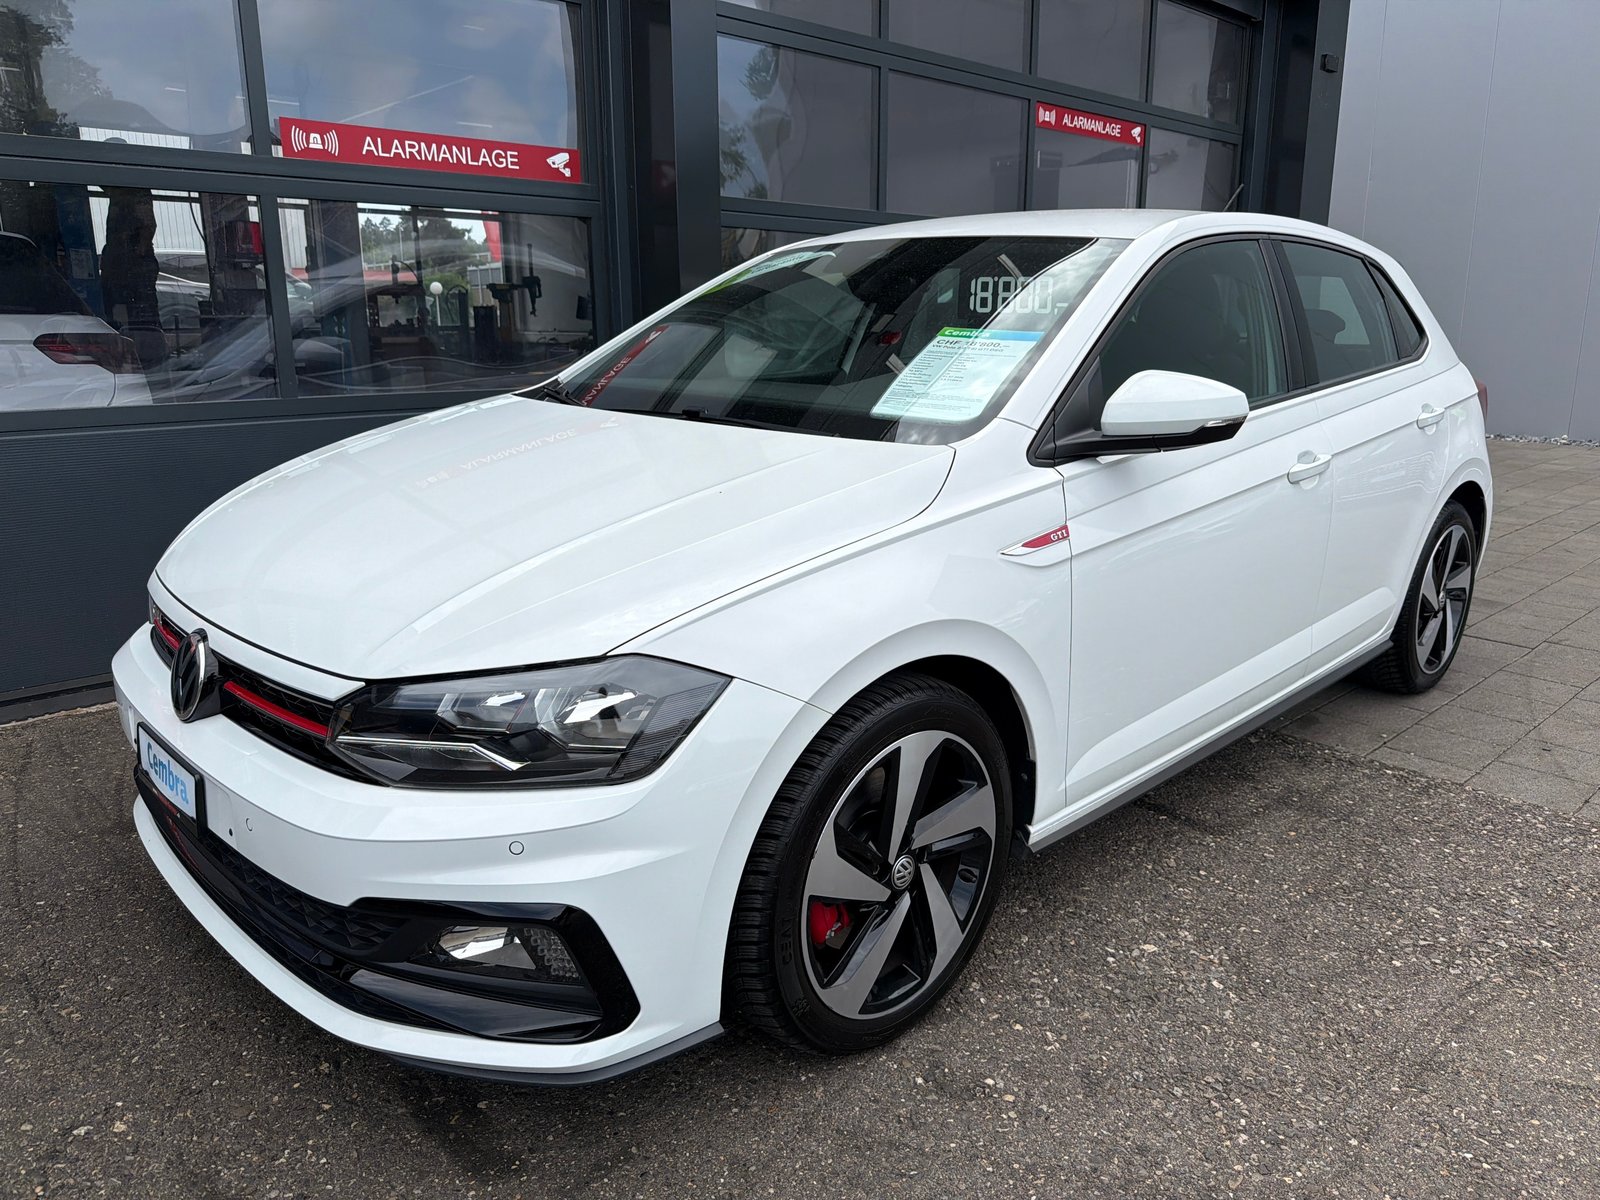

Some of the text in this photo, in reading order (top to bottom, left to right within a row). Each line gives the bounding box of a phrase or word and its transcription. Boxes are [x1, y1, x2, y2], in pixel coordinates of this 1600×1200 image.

[1062, 114, 1121, 137] ALARMANLAGE
[362, 136, 519, 169] ALARMANLAGE
[1050, 530, 1067, 540] GTI
